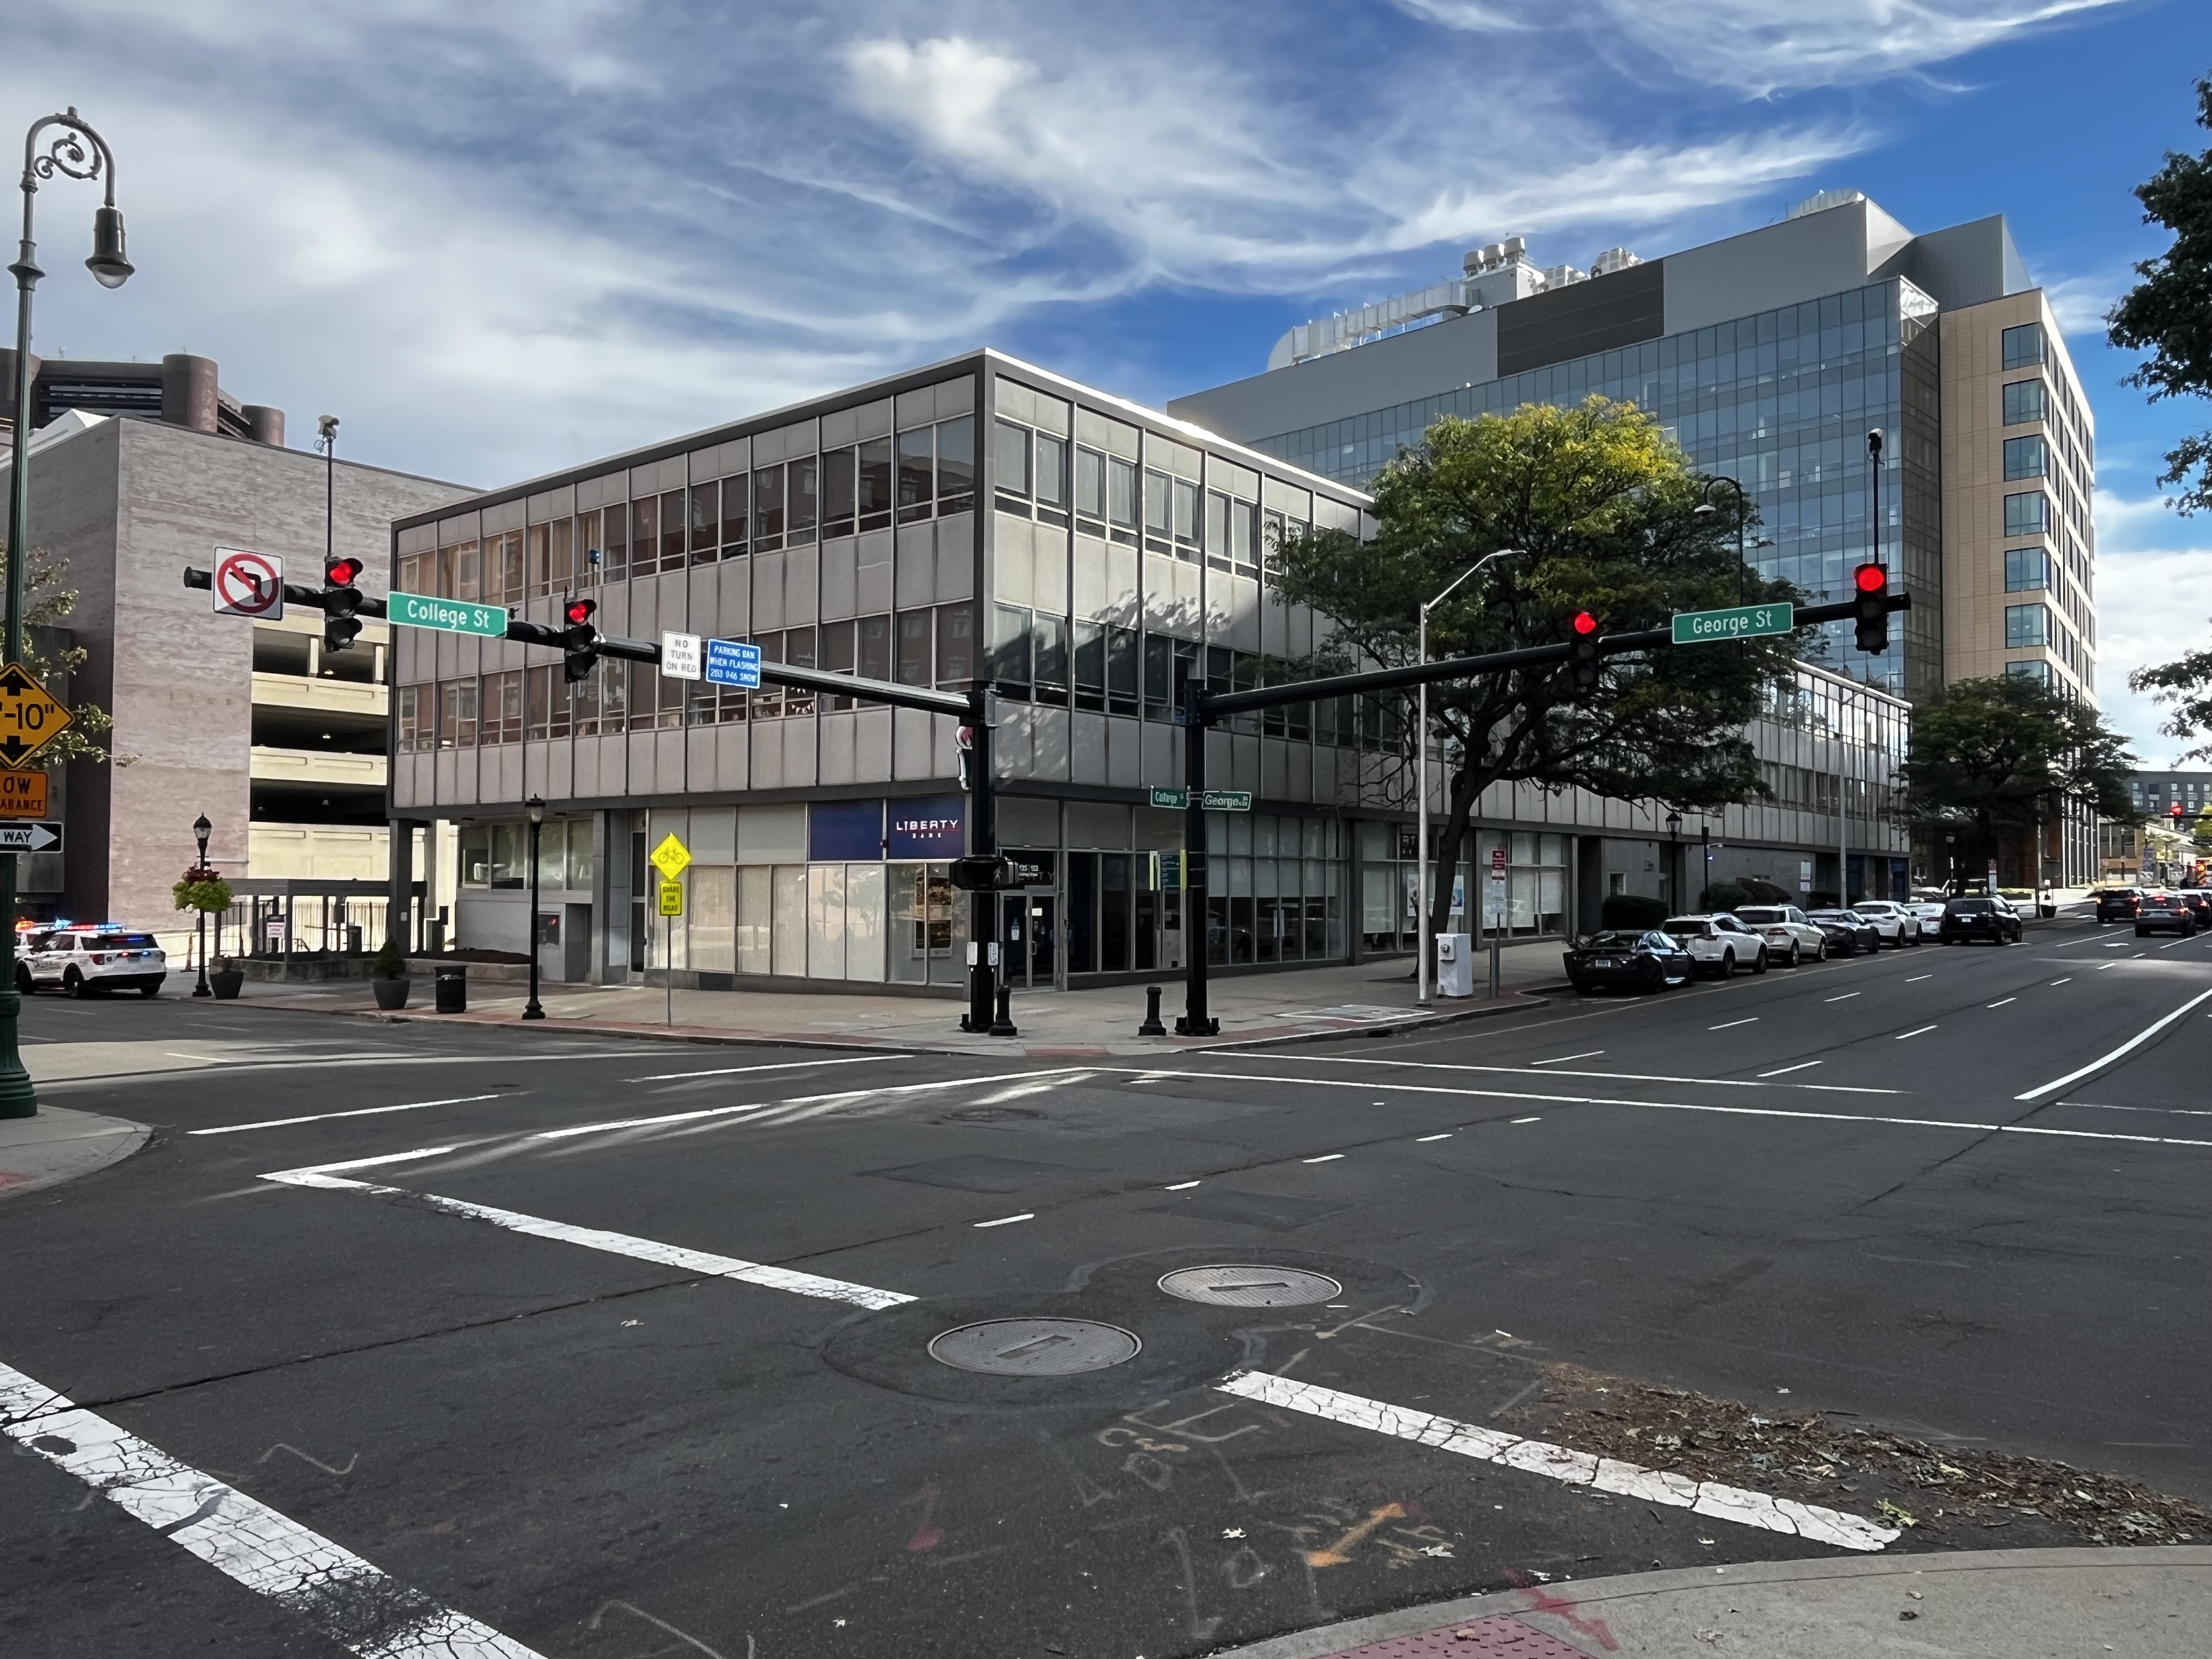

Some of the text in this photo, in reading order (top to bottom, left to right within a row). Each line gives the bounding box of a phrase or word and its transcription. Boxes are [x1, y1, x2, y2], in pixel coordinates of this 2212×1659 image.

[407, 600, 489, 629] College St
[1693, 610, 1773, 636] George St
[675, 639, 689, 648] NO
[671, 650, 692, 661] TURN
[666, 661, 697, 673] ON RED
[0, 776, 31, 794] OW
[0, 798, 43, 811] ARANCE
[1205, 794, 1239, 809] George
[896, 819, 958, 831] LIBERTY
[3, 831, 32, 843] WAY
